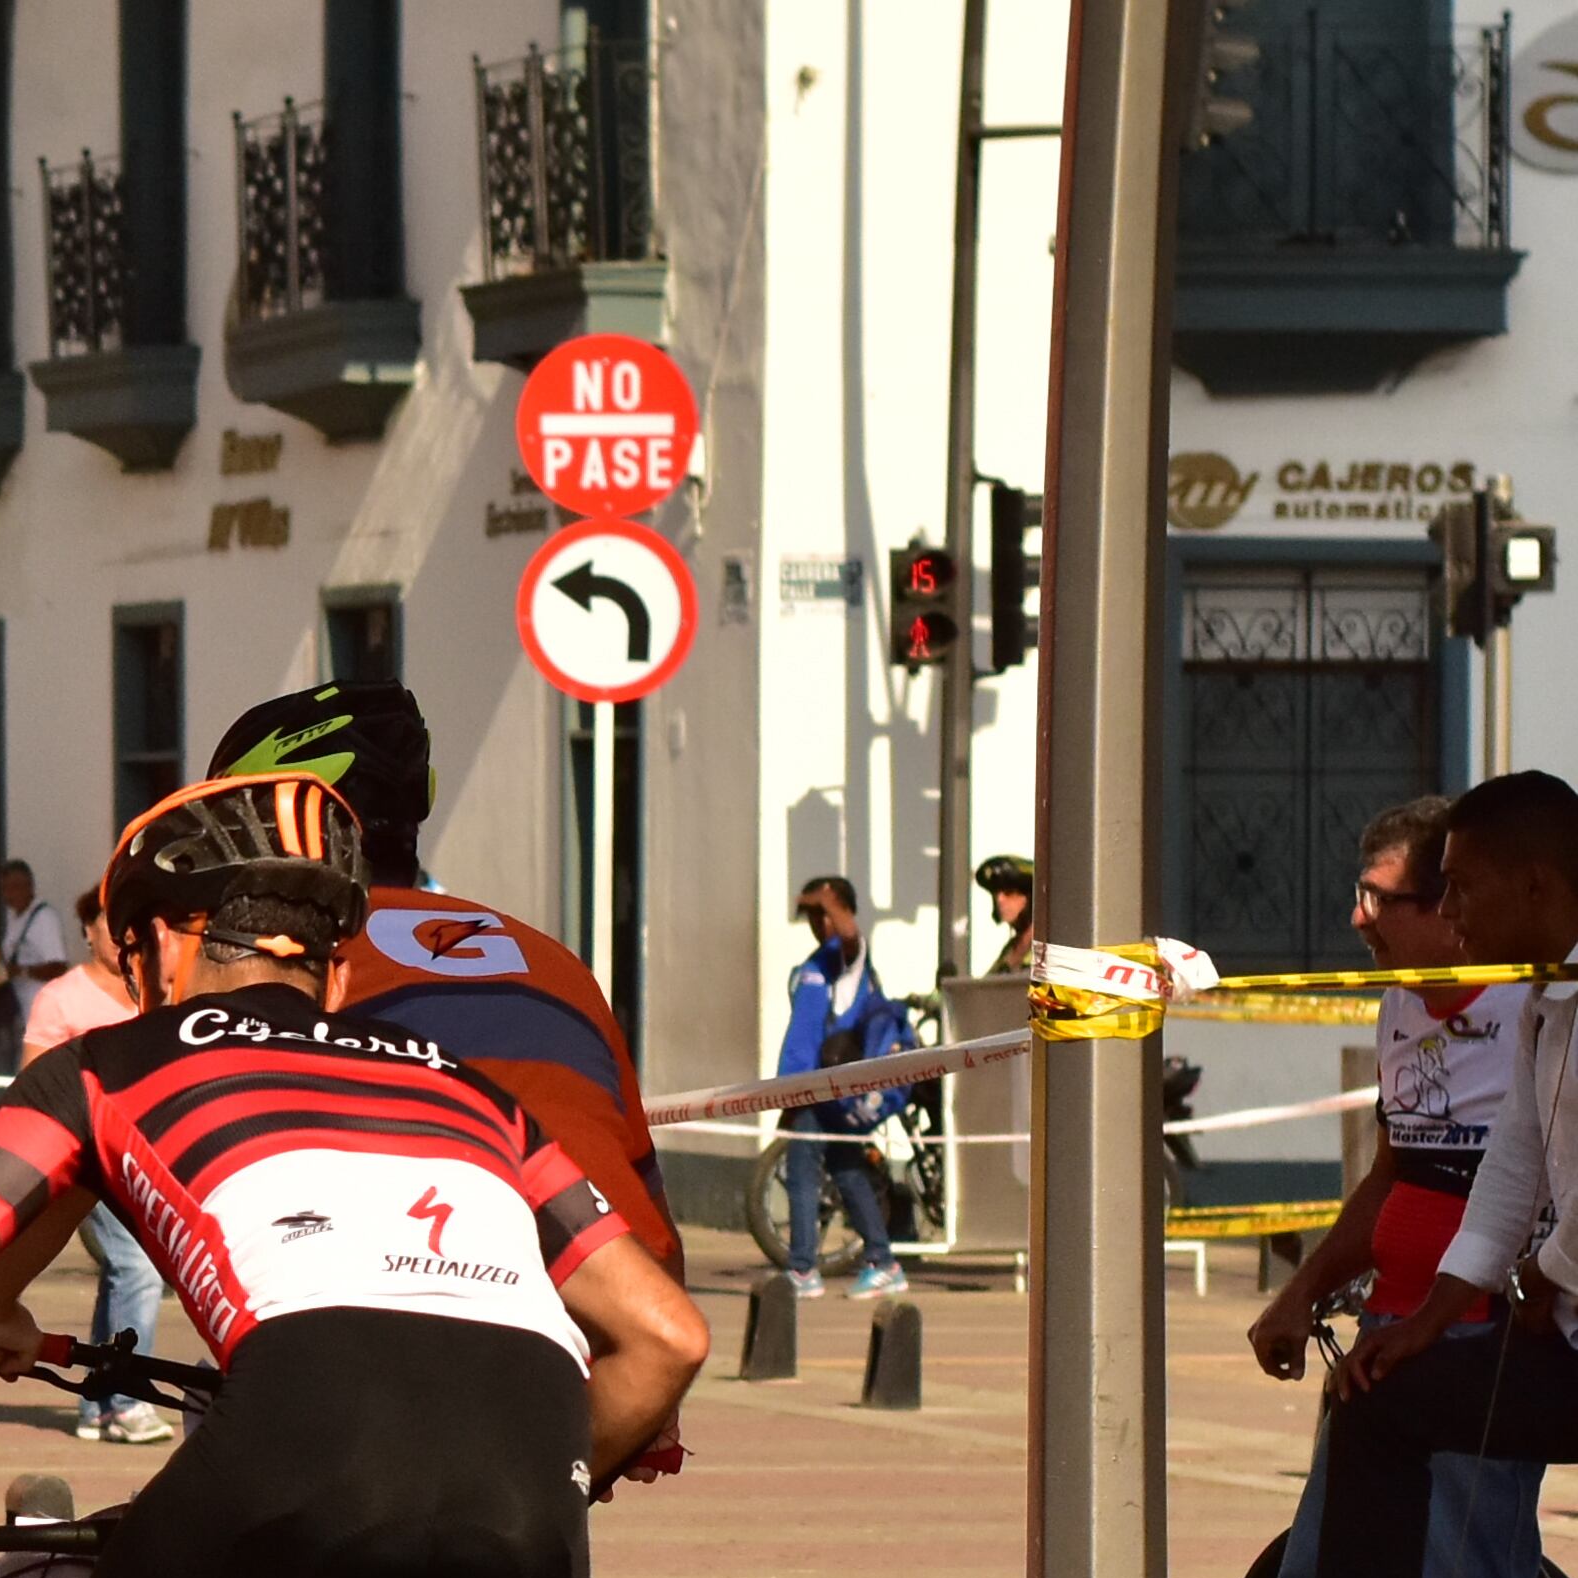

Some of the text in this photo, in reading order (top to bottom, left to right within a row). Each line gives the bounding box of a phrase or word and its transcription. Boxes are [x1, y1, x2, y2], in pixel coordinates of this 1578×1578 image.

[572, 359, 642, 412] NO
[544, 437, 673, 490] PASE
[1277, 460, 1475, 494] CAJEROS
[912, 559, 936, 594] 15
[122, 1152, 238, 1344] SPECIALIZED
[380, 1254, 520, 1286] SPECIALIZED
